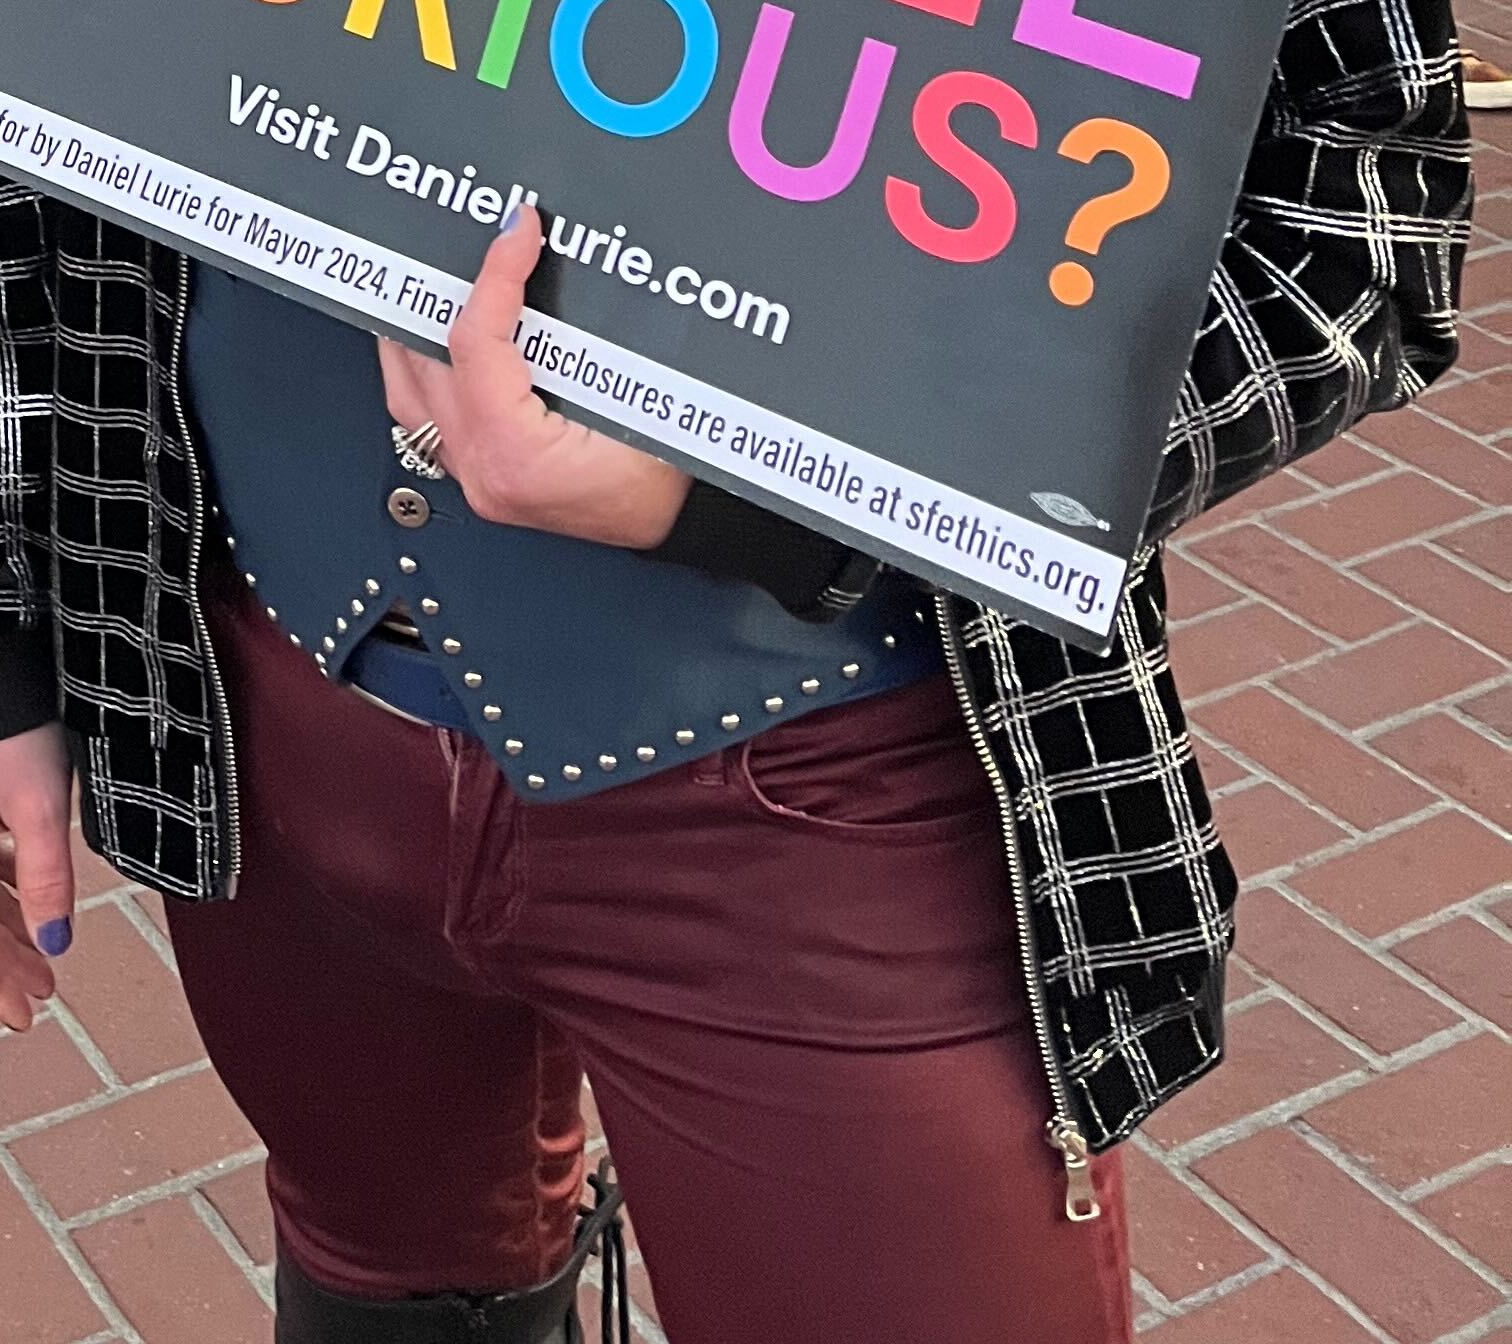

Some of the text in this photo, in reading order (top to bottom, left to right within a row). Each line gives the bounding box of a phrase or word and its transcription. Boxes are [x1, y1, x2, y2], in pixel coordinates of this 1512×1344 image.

[229, 74, 340, 160] Visit
[30, 123, 61, 167] by
[62, 138, 140, 194] Daniel
[140, 170, 201, 219] Lurie
[205, 196, 242, 236] for
[244, 213, 324, 270] Mayor
[324, 248, 388, 300] 2024.
[524, 329, 675, 421] disclosures
[679, 403, 726, 444] are
[730, 424, 864, 504] available
[869, 485, 901, 522] at
[905, 500, 1105, 613] sfethics.org.
